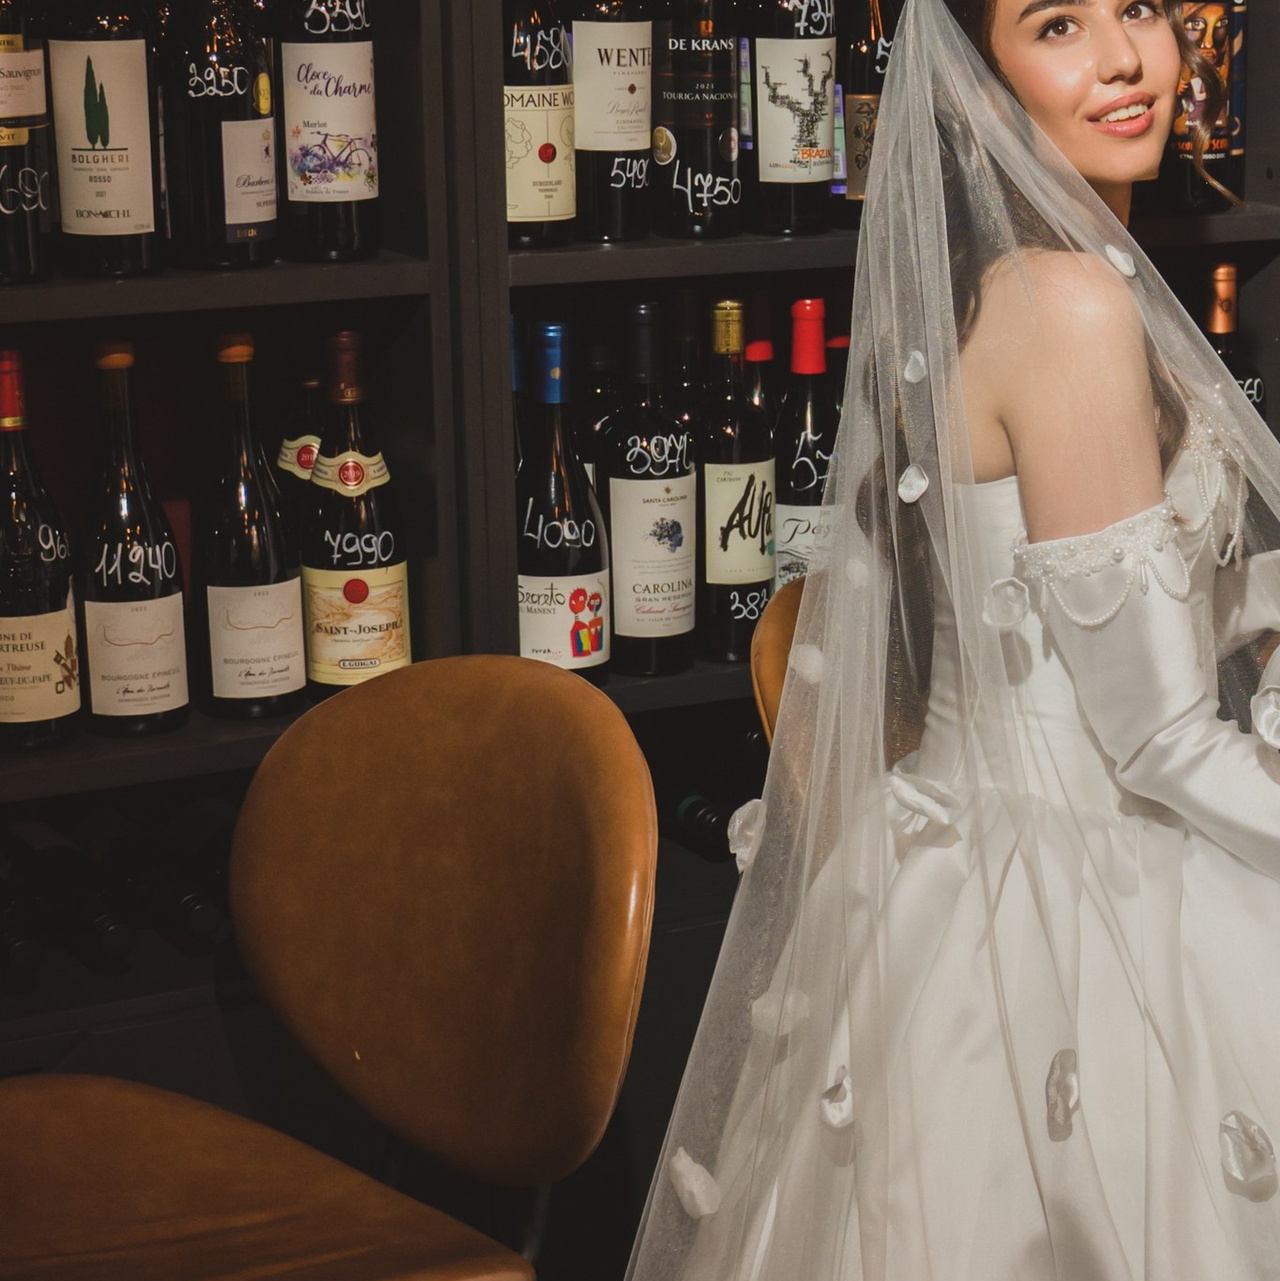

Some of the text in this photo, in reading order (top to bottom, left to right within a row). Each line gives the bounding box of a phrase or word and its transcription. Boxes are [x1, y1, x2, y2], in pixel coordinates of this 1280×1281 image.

[668, 36, 735, 51] DE KRANS
[662, 91, 701, 101] TOURIGA
[71, 153, 129, 165] BOLGHERI
[88, 175, 112, 184] ROSSO
[672, 159, 742, 214] 4750
[632, 579, 693, 595] CAROLINA
[527, 606, 557, 615] MANENT
